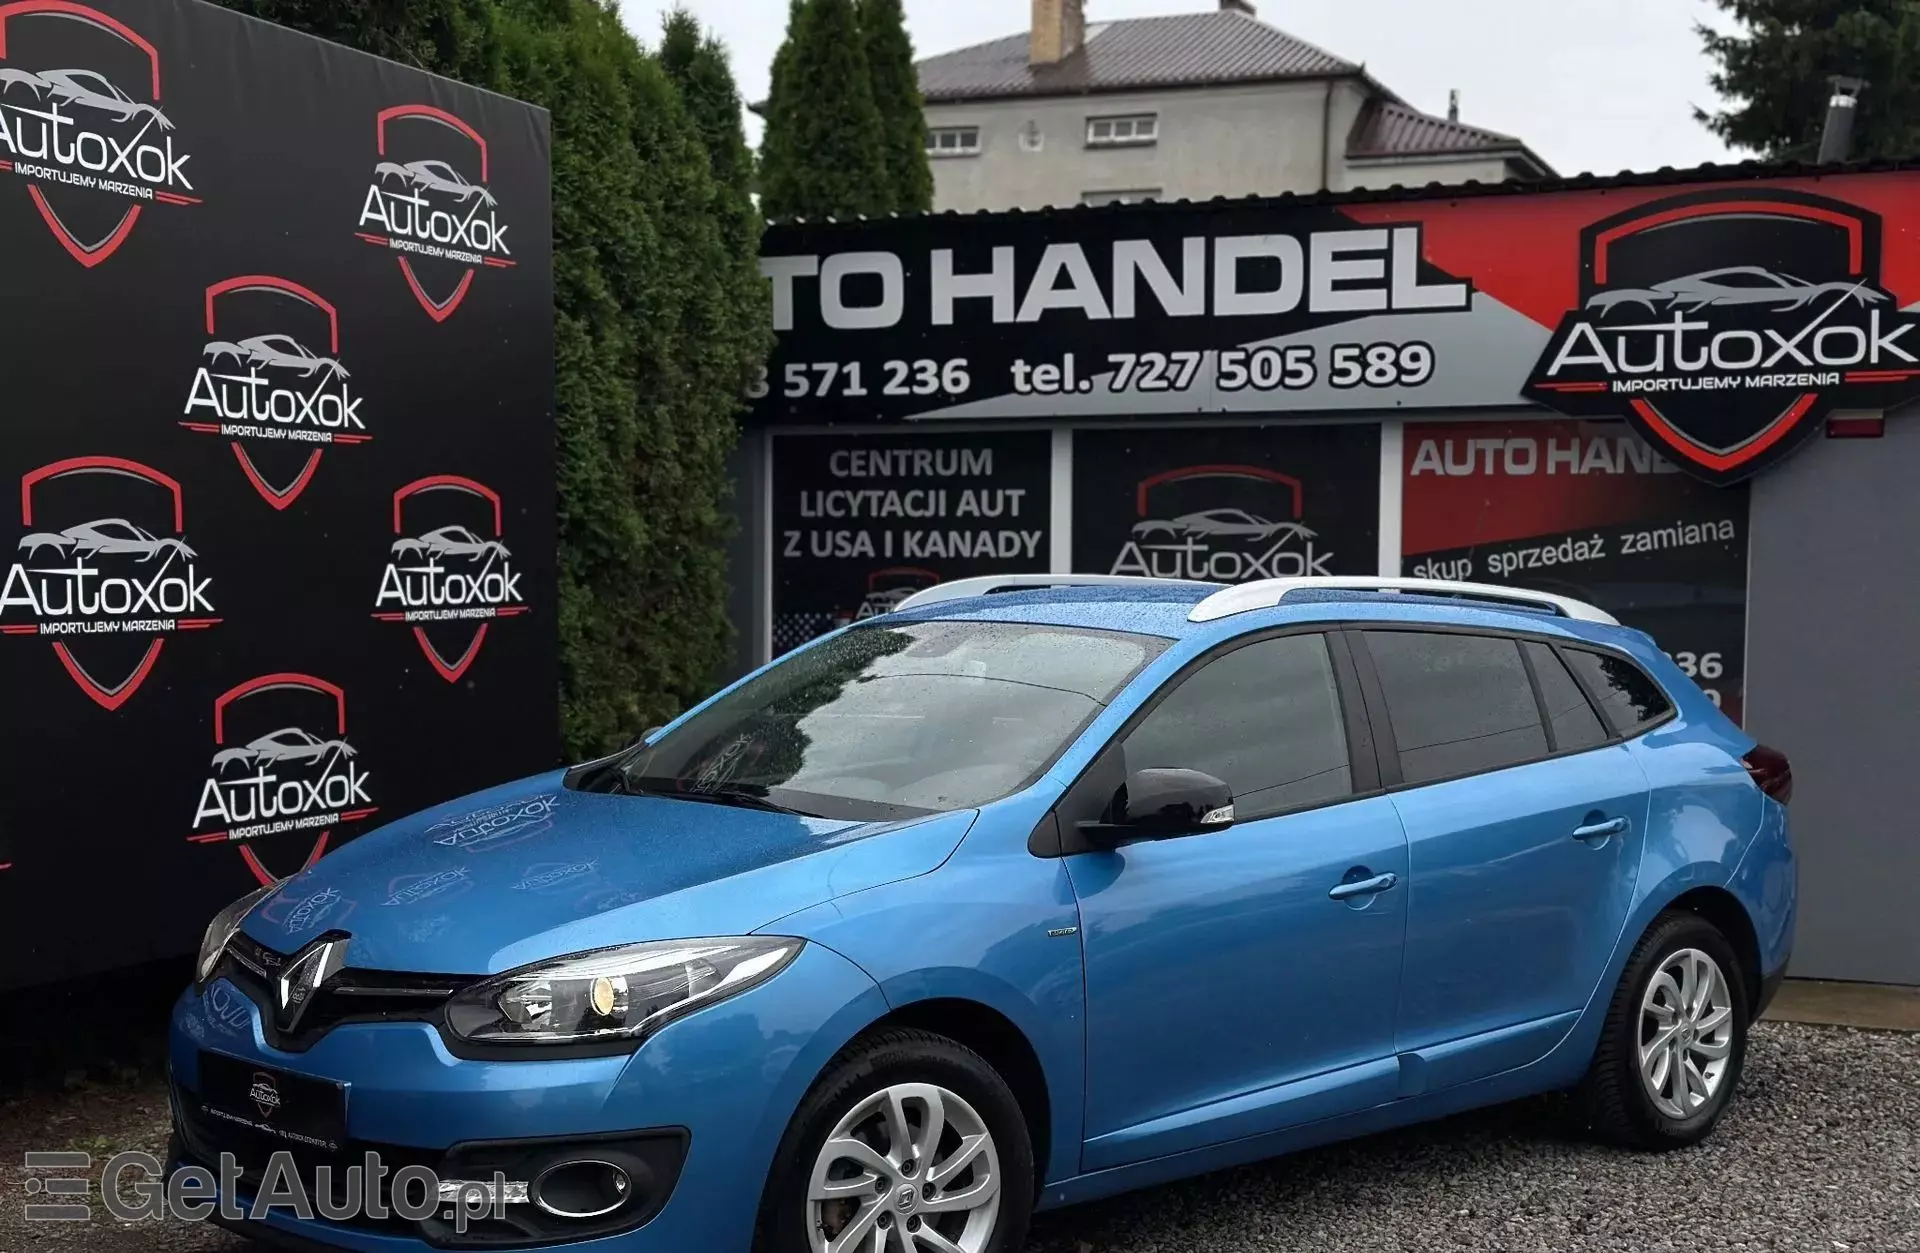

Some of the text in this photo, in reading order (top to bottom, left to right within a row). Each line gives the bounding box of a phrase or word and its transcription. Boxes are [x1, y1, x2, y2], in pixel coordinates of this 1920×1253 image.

[14, 161, 153, 200] IMPORTUJEMY MARZENIA
[359, 184, 511, 255] Autoxok
[389, 237, 482, 264] IMPORTUJEMY MARZENIA
[758, 227, 1467, 331] TO HANDEL
[1547, 280, 1919, 376] Autoxok
[784, 362, 868, 398] 571
[882, 358, 970, 396] 236
[1011, 353, 1091, 393] tel.
[1107, 351, 1200, 391] 727
[1218, 348, 1314, 388] 505
[1329, 344, 1433, 385] 589
[1613, 372, 1840, 393] IMPORTUJEMY MARZENIA
[184, 361, 365, 429] Autoxok
[221, 424, 332, 443] IMPORTUJEMY MARZENIA
[829, 449, 993, 477] CENTRUM
[1410, 437, 1537, 476] AUTO
[801, 489, 1025, 519] LICYTACJI AUT
[783, 530, 1042, 558] Z USA I KANADY
[1110, 528, 1334, 579] Autoxok
[1413, 518, 1734, 582] skup sprzedaż zamiana
[0, 540, 214, 616] Autoxok
[375, 540, 523, 608] Autoxok
[40, 619, 175, 634] IMPORTUJEMY MARZENIA
[405, 607, 496, 622] IMPORTUJEMY MARZENIA
[1675, 651, 1723, 678] 36
[192, 739, 372, 829] Autoxok
[229, 812, 339, 840] IMPORTUJEMY MARZENIA
